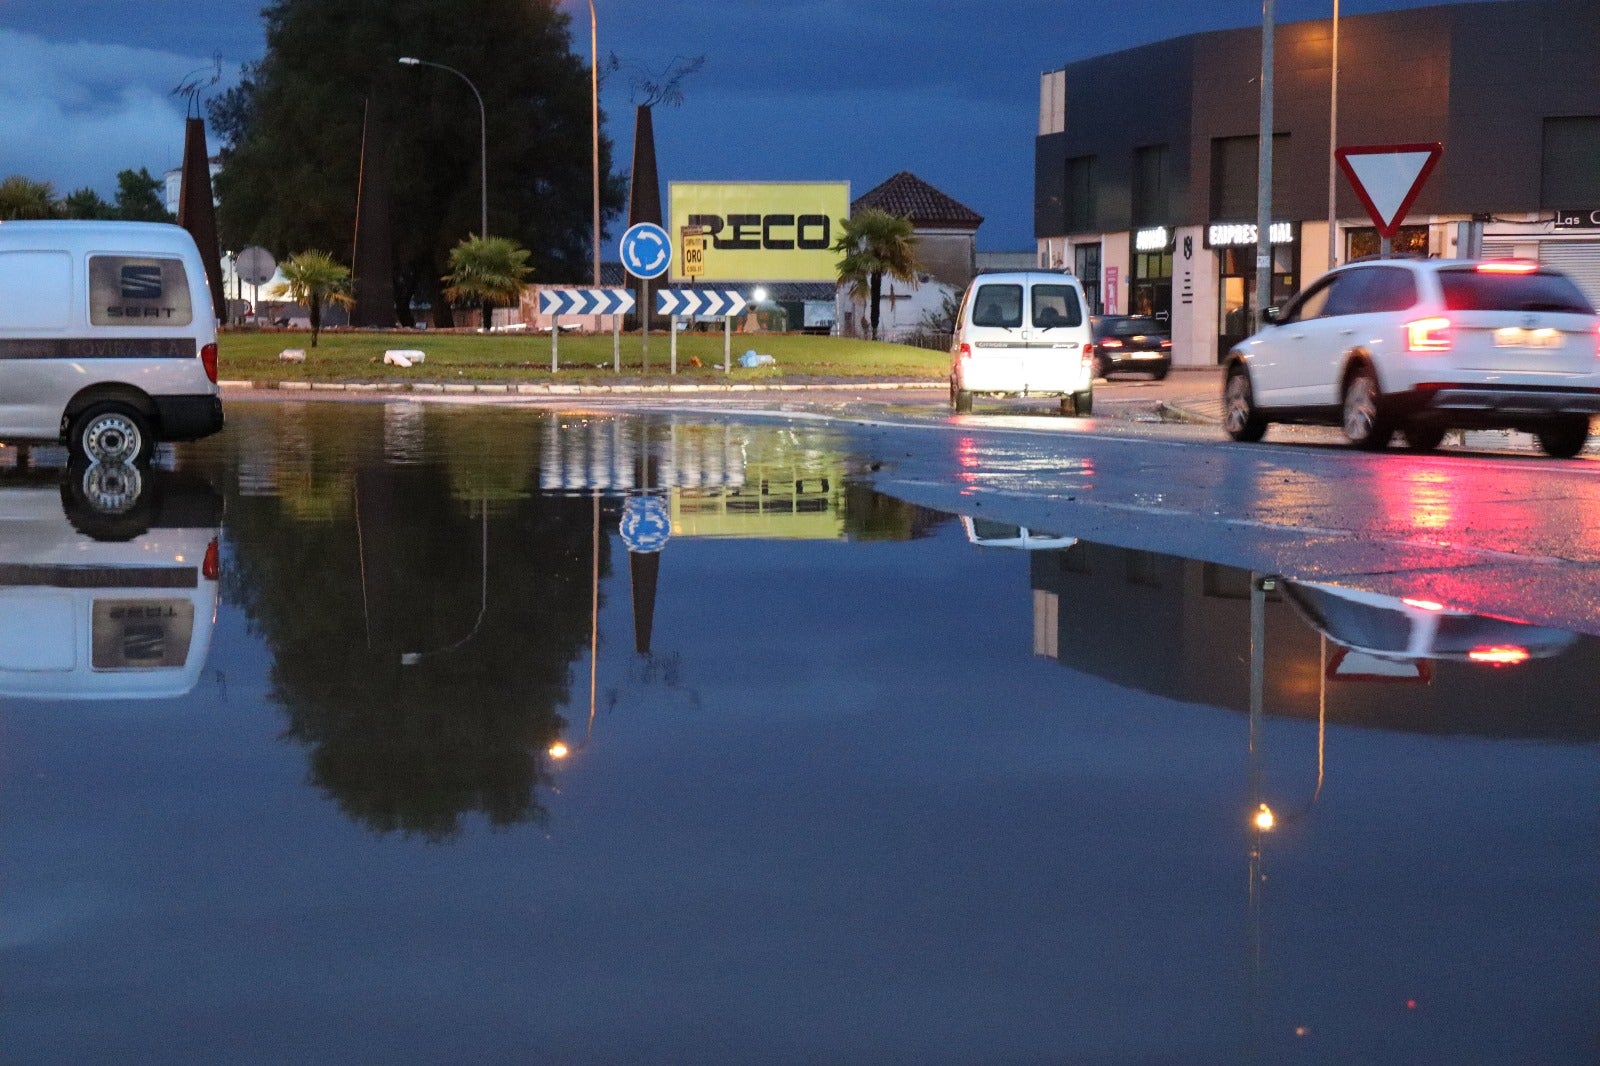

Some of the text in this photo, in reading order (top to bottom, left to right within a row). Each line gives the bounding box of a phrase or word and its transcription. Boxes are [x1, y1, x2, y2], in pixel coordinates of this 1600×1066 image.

[1555, 210, 1580, 226] Las
[688, 214, 830, 250] RECO
[686, 249, 702, 263] ORO
[107, 306, 176, 318] SEAT
